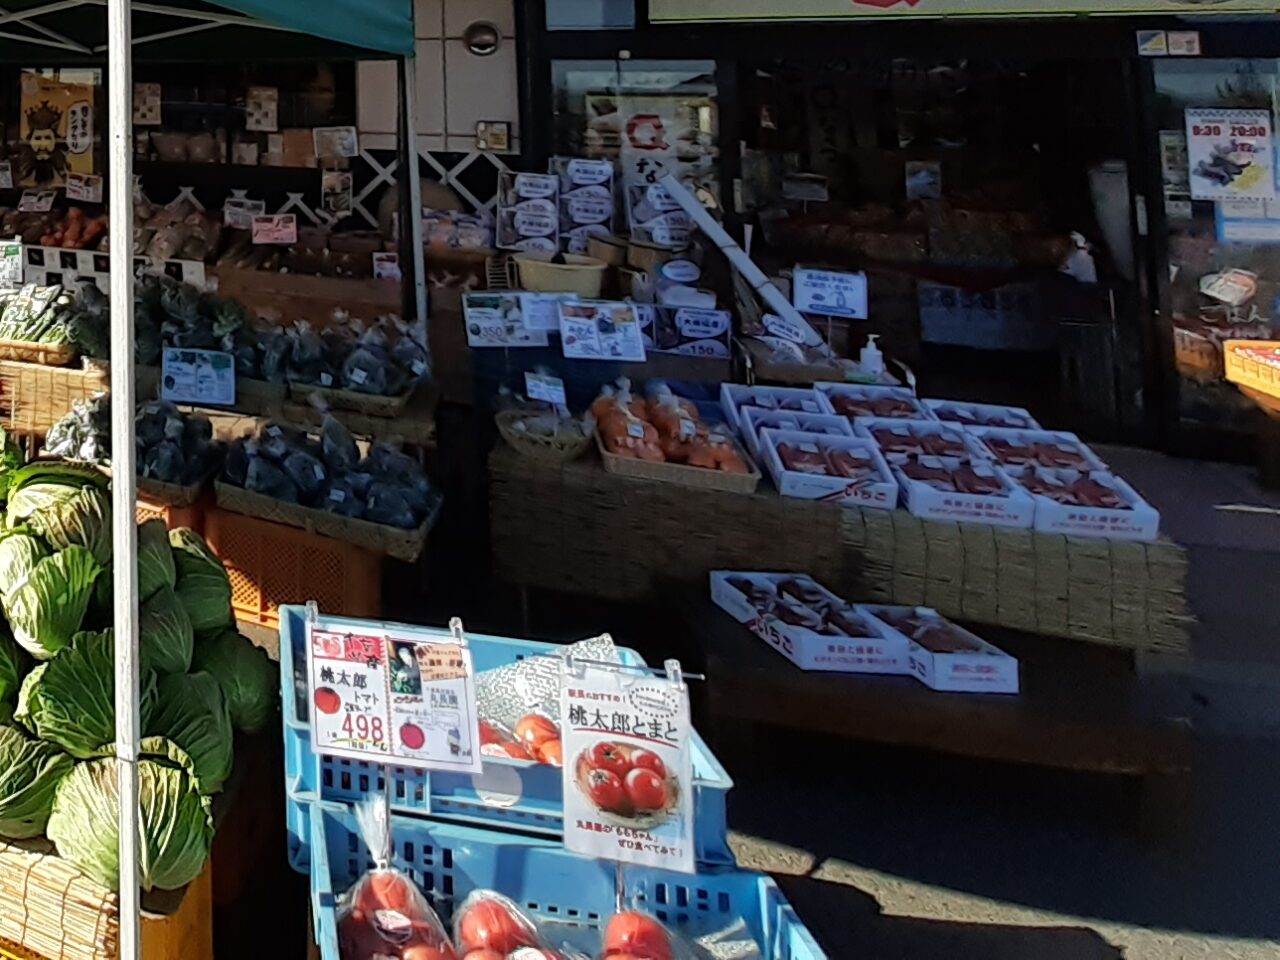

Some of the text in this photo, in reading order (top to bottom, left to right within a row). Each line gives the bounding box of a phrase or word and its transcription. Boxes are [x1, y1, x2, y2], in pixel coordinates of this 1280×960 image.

[321, 666, 368, 688] 桃太郎
[354, 691, 380, 706] トマト
[342, 713, 384, 742] 498
[568, 703, 679, 741] 桃太郎とまと
